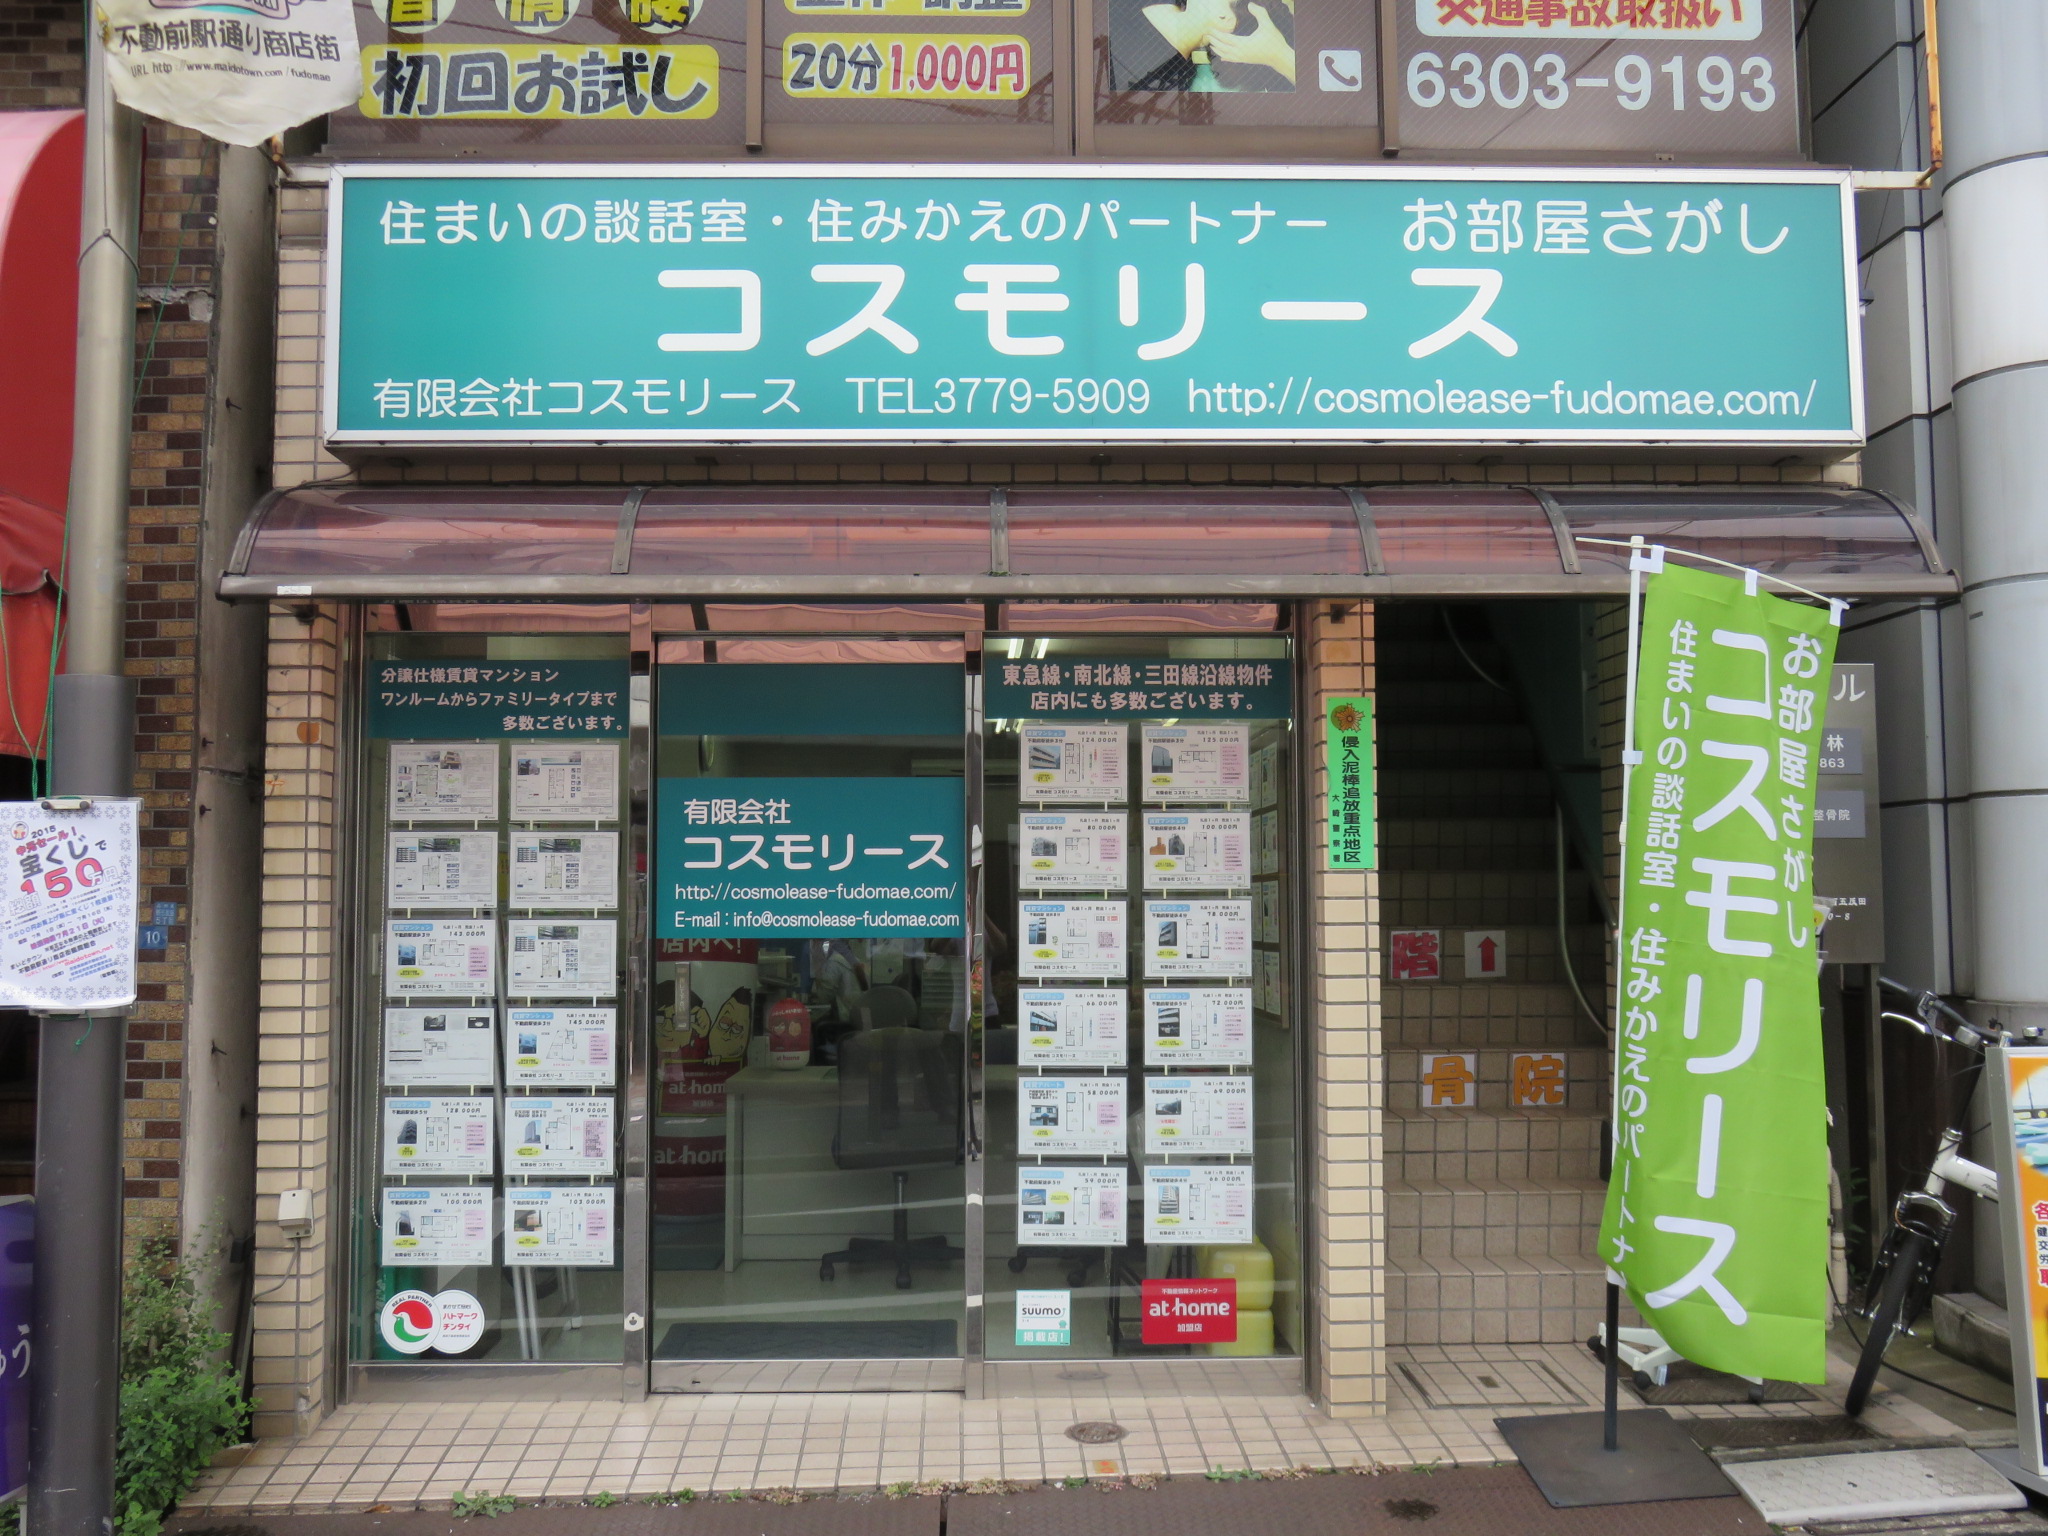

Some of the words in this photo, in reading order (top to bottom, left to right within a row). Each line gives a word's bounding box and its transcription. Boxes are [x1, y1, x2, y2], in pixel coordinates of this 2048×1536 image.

[114, 18, 341, 62] 不動前駅通り商店街
[131, 66, 150, 78] URL
[372, 49, 709, 116] 初回お試し
[1406, 51, 1776, 112] 6303-9193
[1403, 198, 1789, 255] お部屋さがし
[657, 263, 1519, 361] コスモリース
[373, 377, 801, 421] 有限会社コスモリース
[846, 377, 1151, 416] TEL3779-5909
[1187, 376, 1818, 420] http://cosmolease-fudomae.com/
[381, 667, 559, 684] 分譲仕様賃貸マンション
[381, 691, 618, 707] ワンルームからファミリータイプまで
[1030, 691, 1255, 710] 店内にも多数ございます。
[502, 715, 623, 731] 多数ございます。
[1341, 736, 1361, 863] 侵入泥棒追放重点地区
[1777, 632, 1824, 948] お部屋さがし
[684, 798, 791, 825] 有限会社
[31, 825, 56, 838] 2015
[683, 833, 950, 872] コスモリース
[675, 882, 958, 902] http://cosmolease-fudomae.com/
[733, 910, 960, 927] info@cosmolease-fudomae.com
[146, 931, 160, 943] 10
[1645, 628, 1777, 1326] コスモリース
[688, 1080, 726, 1094] hom
[1424, 1056, 1474, 1105] 骨
[1513, 1055, 1564, 1104] 院
[678, 1145, 726, 1164] hom
[1149, 1301, 1170, 1316] at
[1171, 1297, 1230, 1316] home
